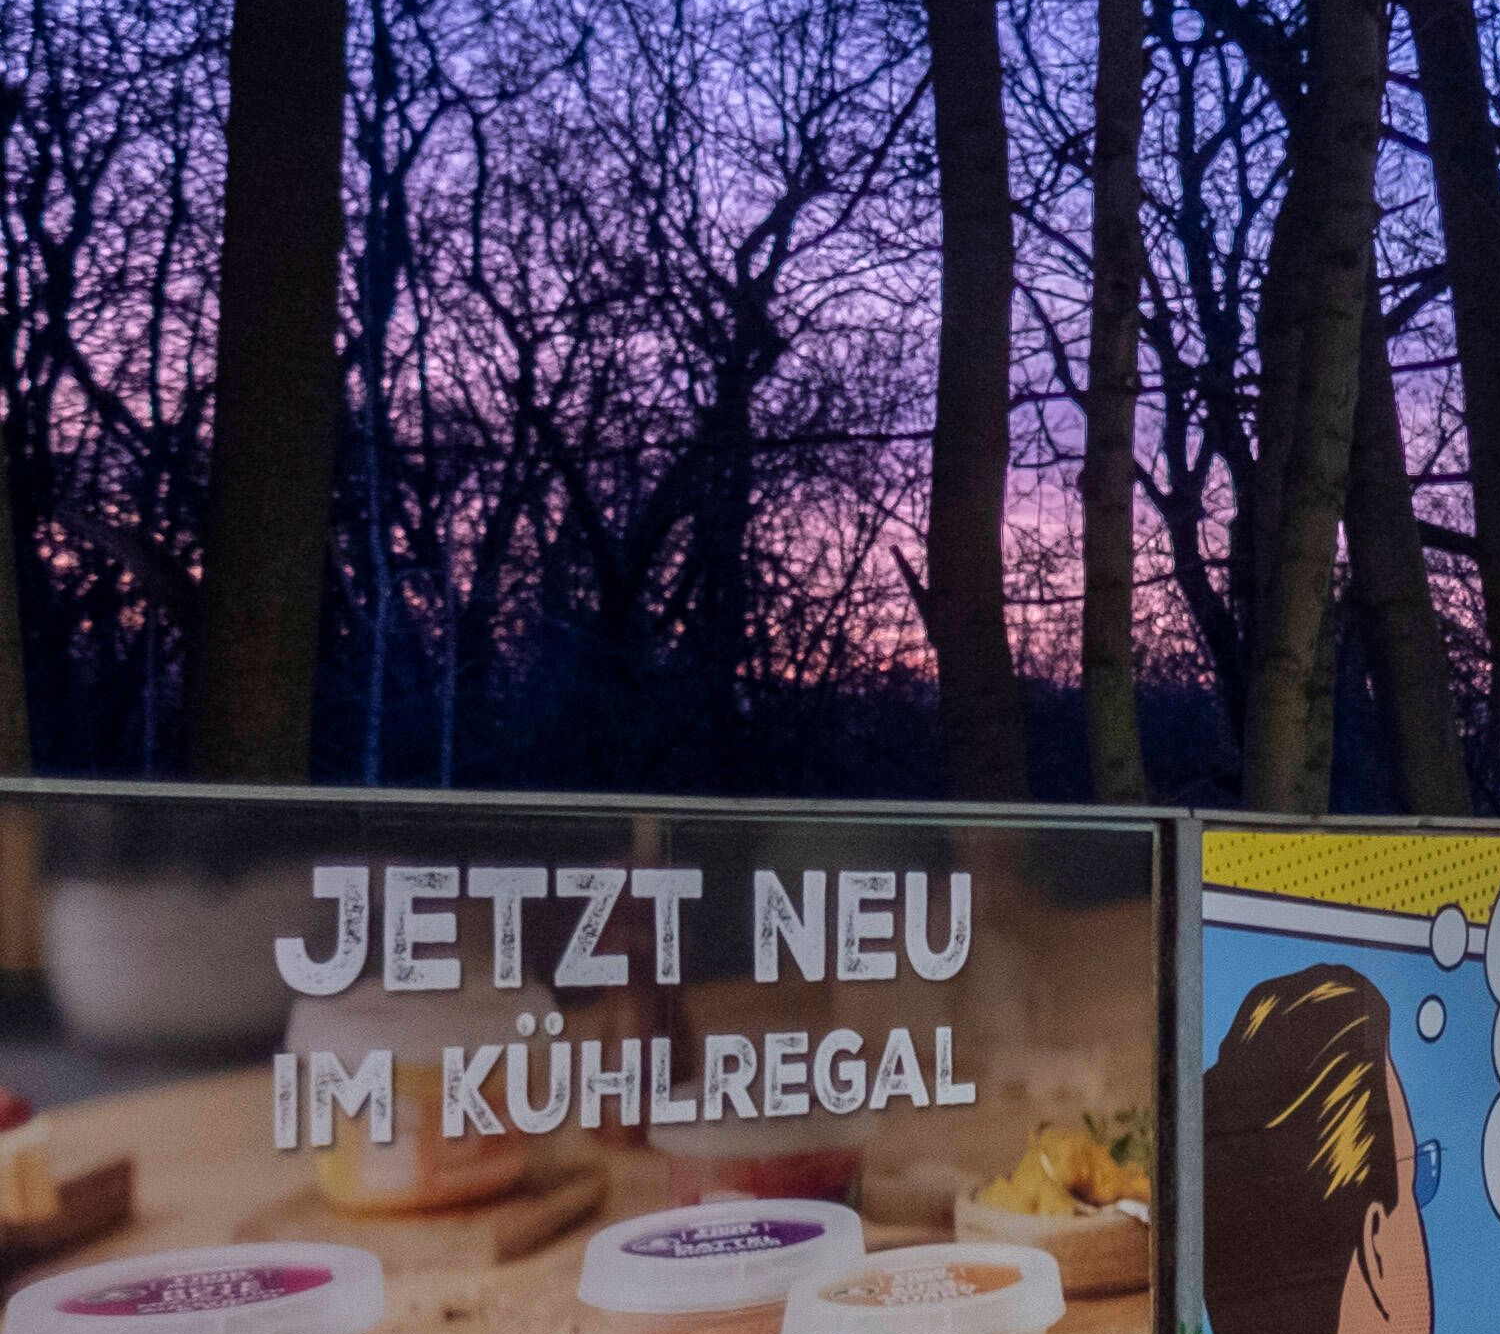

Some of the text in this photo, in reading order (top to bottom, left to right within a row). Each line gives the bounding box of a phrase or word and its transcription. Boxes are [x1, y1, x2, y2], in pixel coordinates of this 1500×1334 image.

[274, 865, 973, 994] JETZT NEU
[272, 1012, 977, 1150] IM KÜHLREGAL
